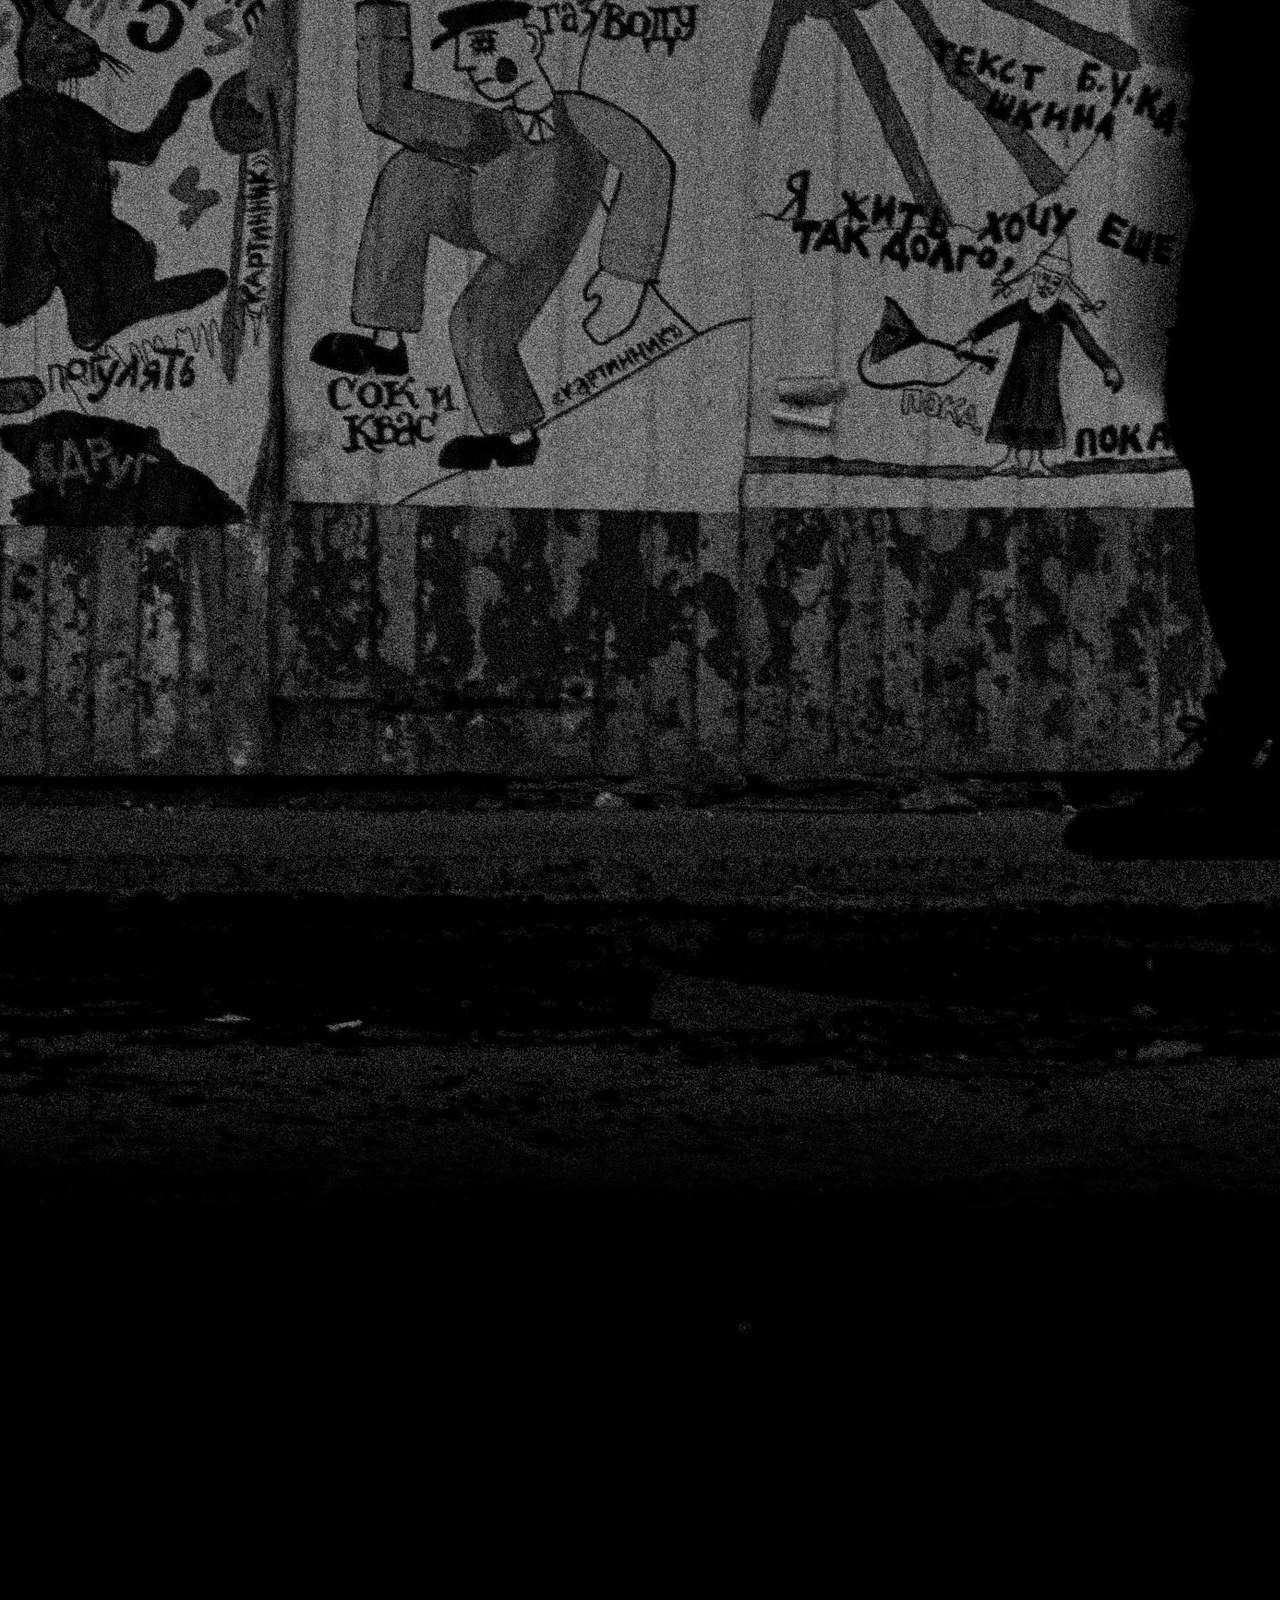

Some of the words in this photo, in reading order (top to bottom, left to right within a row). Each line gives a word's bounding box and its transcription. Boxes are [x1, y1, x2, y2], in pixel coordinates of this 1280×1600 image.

[933, 38, 1045, 91] ТЕКСТ
[985, 90, 1116, 141] ШКИНА
[777, 169, 811, 221] Я
[841, 190, 948, 240] ЖИТЬ
[976, 202, 1077, 244] ХОЧУ
[792, 219, 870, 258] ТАК
[1074, 423, 1172, 458] ПОКА
